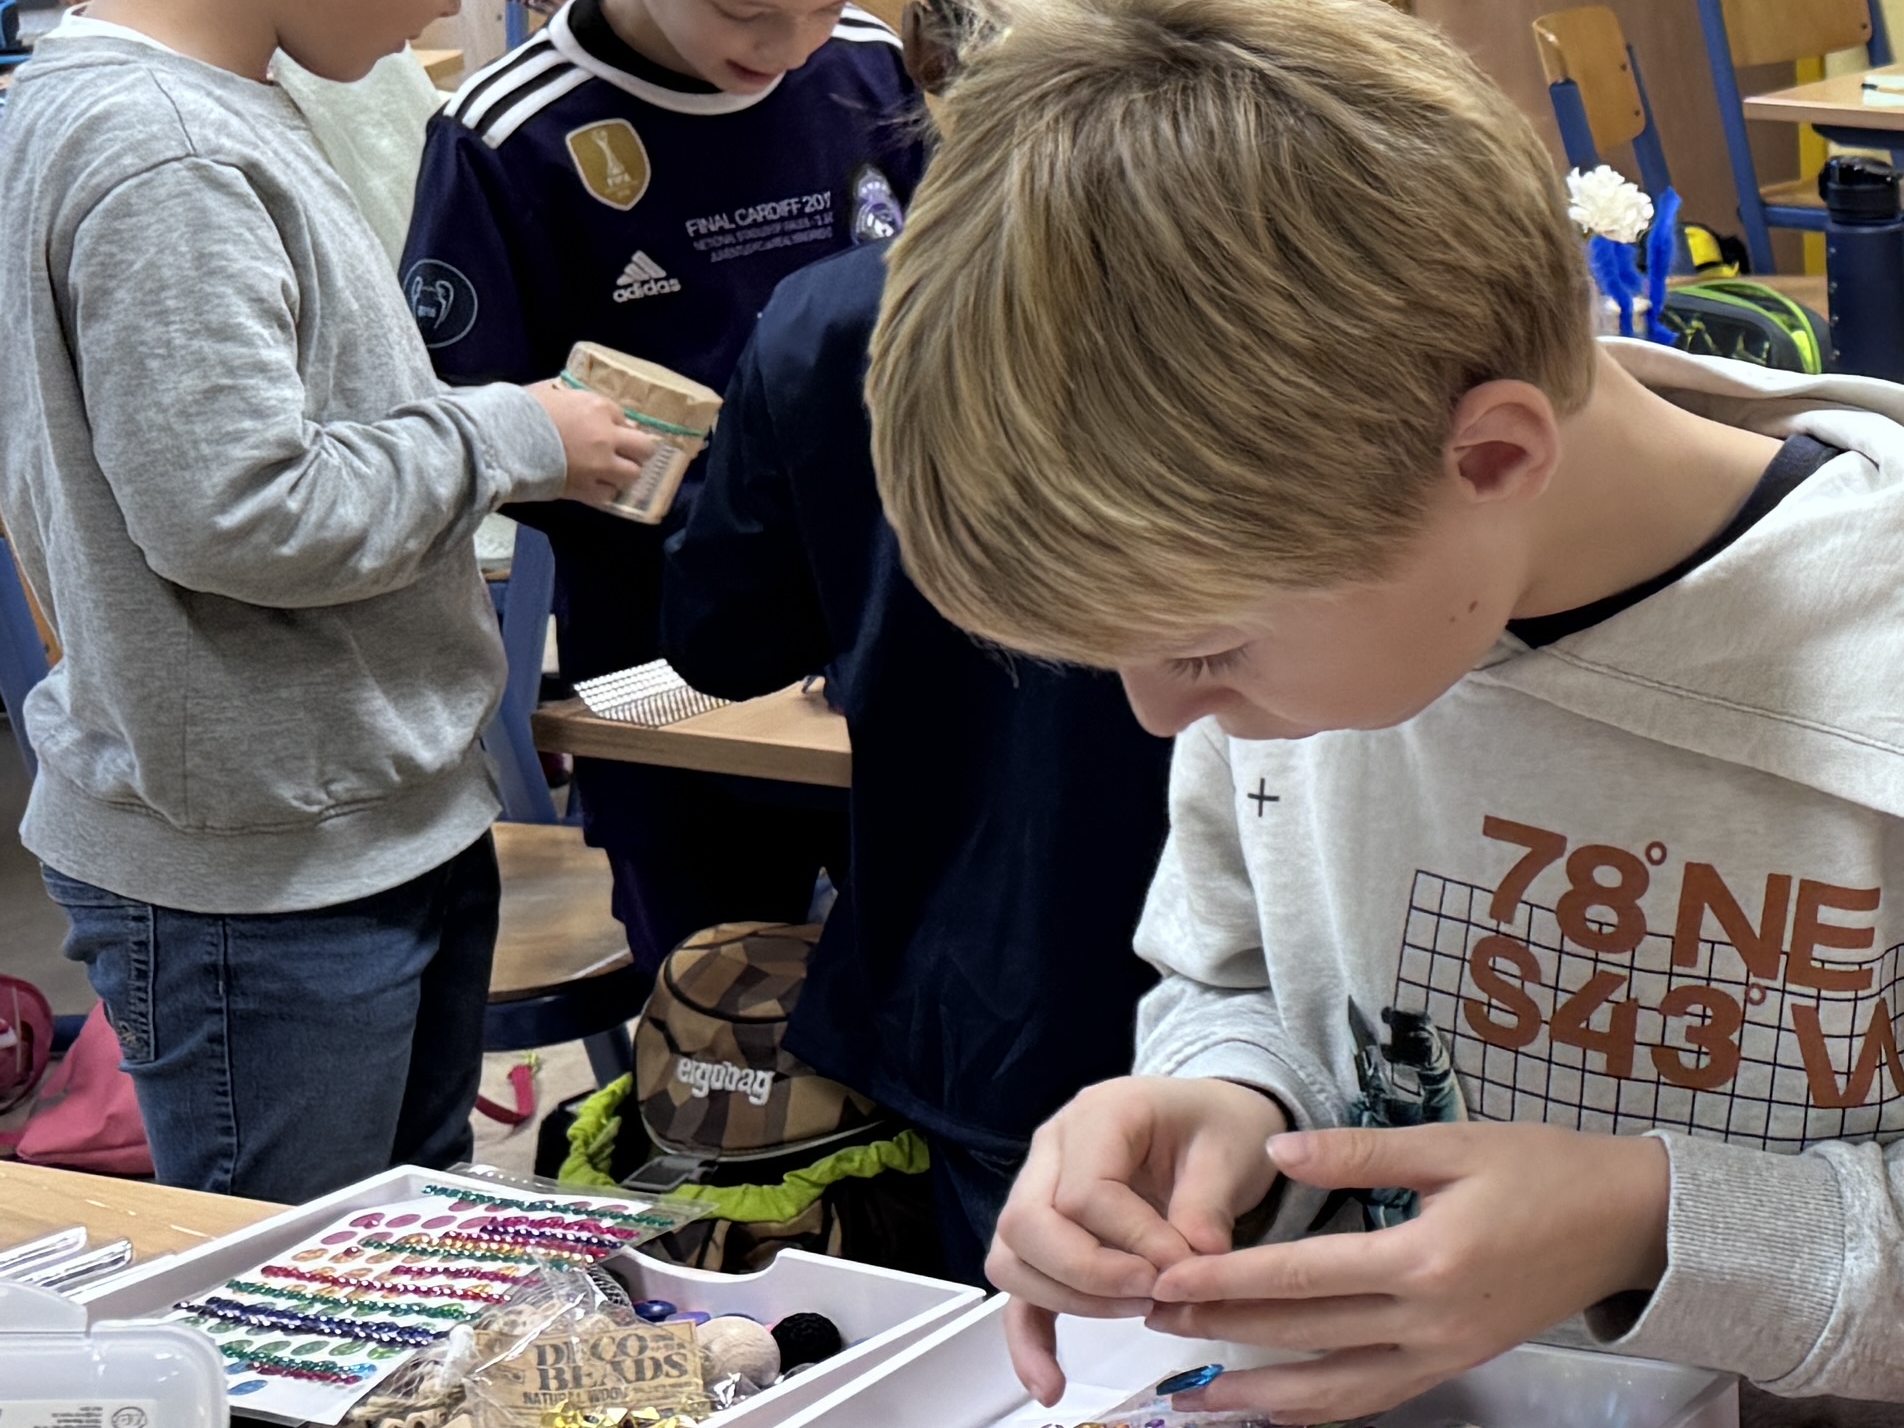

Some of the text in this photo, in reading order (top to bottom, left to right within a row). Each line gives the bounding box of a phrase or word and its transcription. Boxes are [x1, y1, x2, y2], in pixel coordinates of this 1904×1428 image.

[685, 212, 736, 237] FINAL
[734, 198, 802, 227] CARDIFF
[613, 278, 681, 302] adidas
[677, 1057, 775, 1106] ergobag
